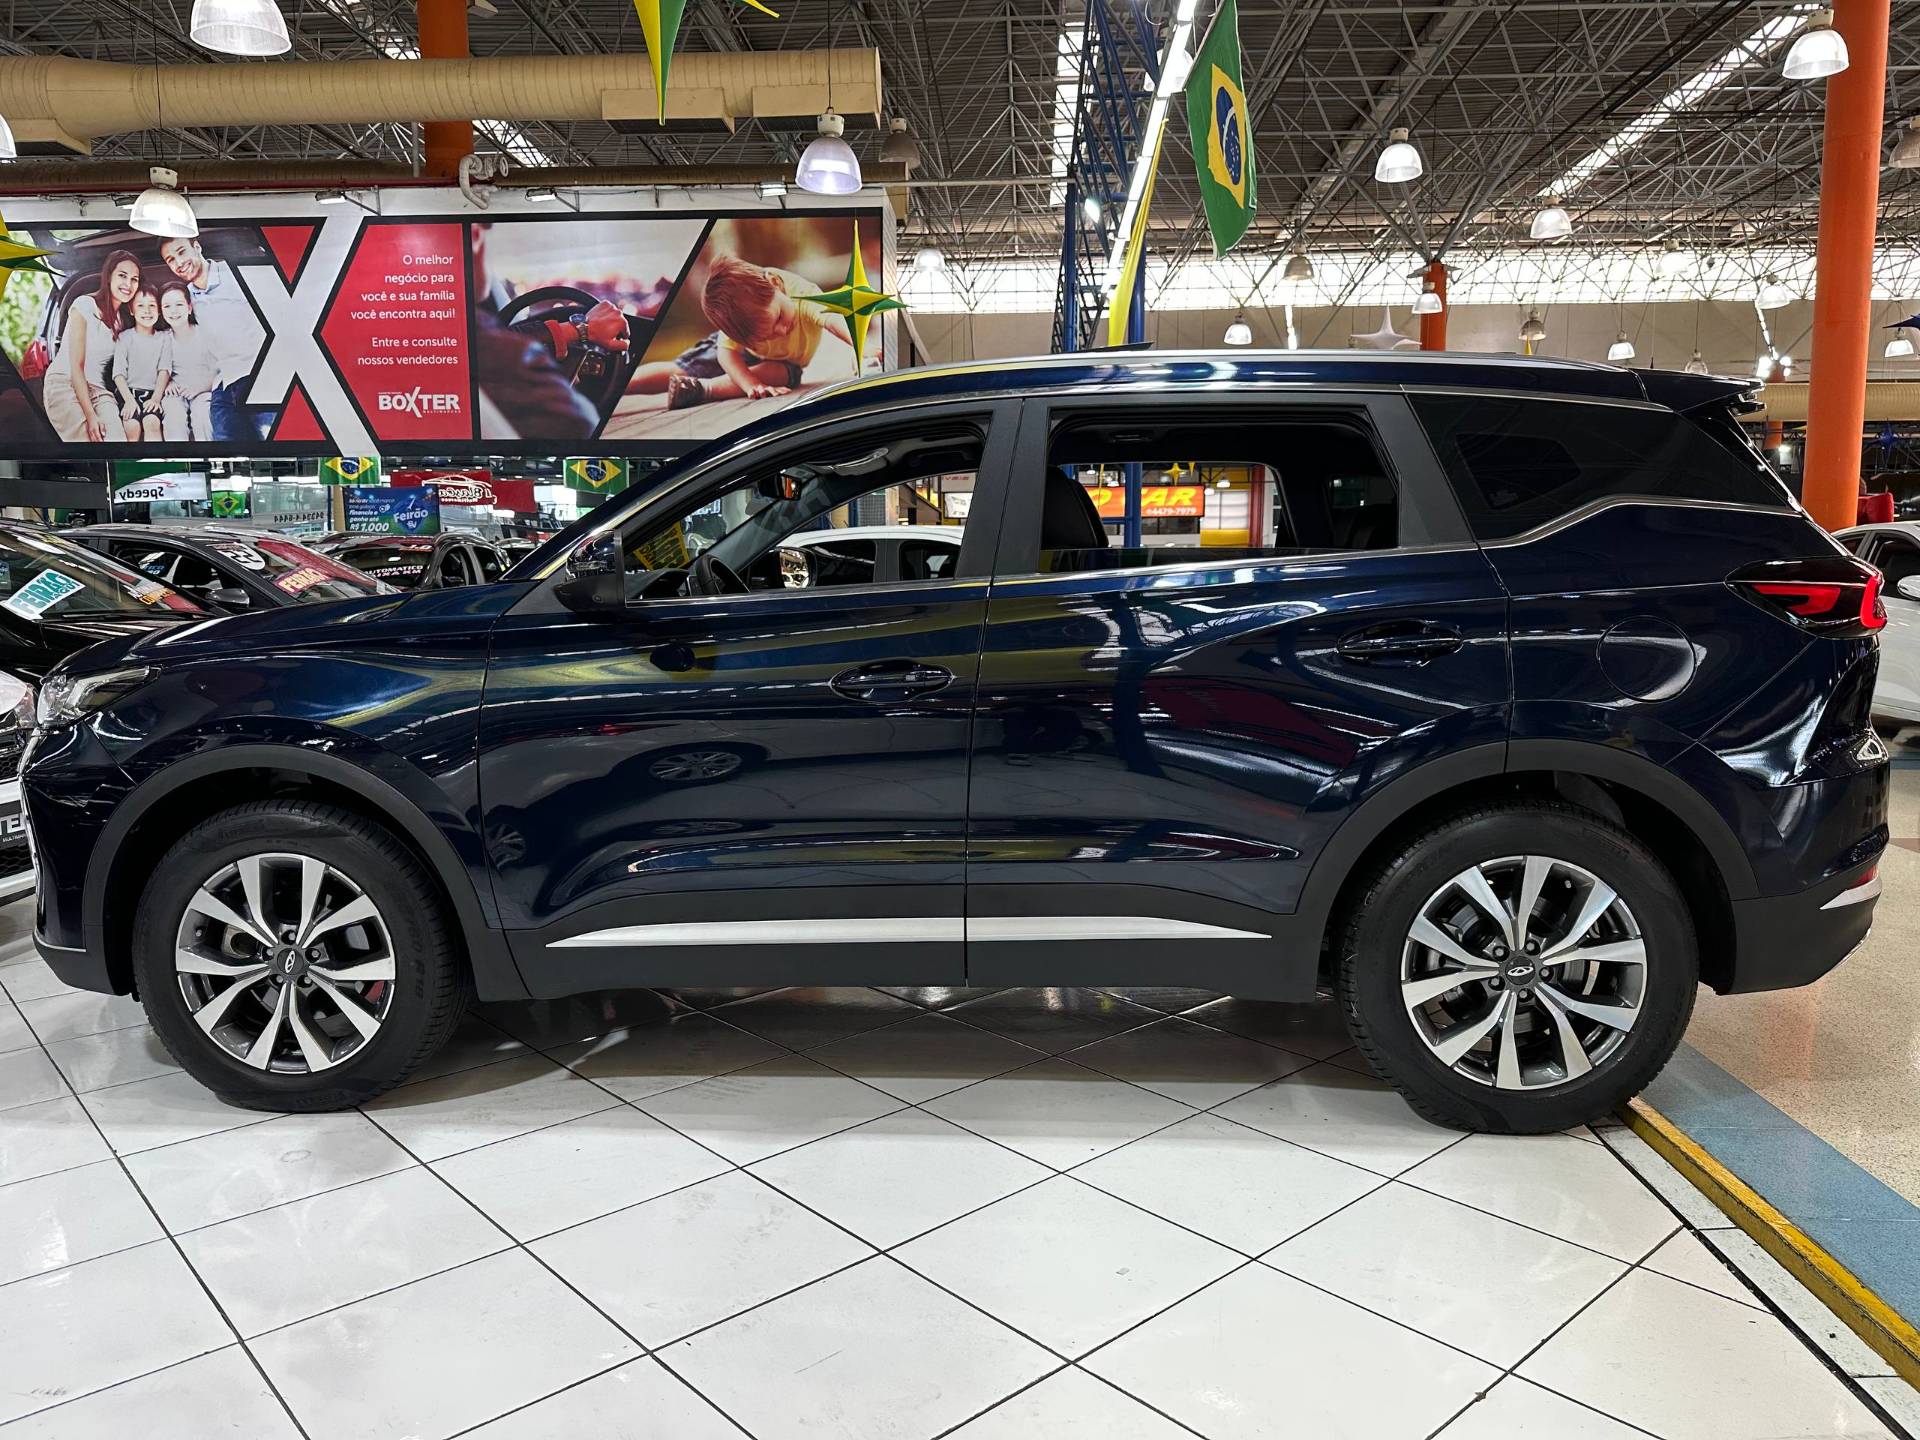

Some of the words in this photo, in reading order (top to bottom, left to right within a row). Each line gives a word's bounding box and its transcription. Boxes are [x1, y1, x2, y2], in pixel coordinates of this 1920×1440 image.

[402, 254, 412, 265] O
[415, 254, 454, 265] melhor
[384, 272, 429, 286] negócio
[431, 274, 455, 285] para
[361, 290, 388, 302] você
[389, 293, 396, 301] e
[399, 292, 417, 301] sua
[419, 290, 455, 301] família
[350, 309, 377, 319] você
[379, 309, 427, 319] encontra
[429, 308, 456, 320] aqui!
[371, 337, 400, 347] Entre
[402, 338, 409, 347] e
[411, 336, 458, 347] consulte
[357, 356, 394, 365] nossos
[396, 355, 459, 365] vendedores
[378, 386, 461, 418] BOXTER
[1141, 487, 1197, 507] AR
[393, 507, 429, 523] Feirão
[350, 523, 360, 532] R$
[360, 522, 390, 532] 1.000
